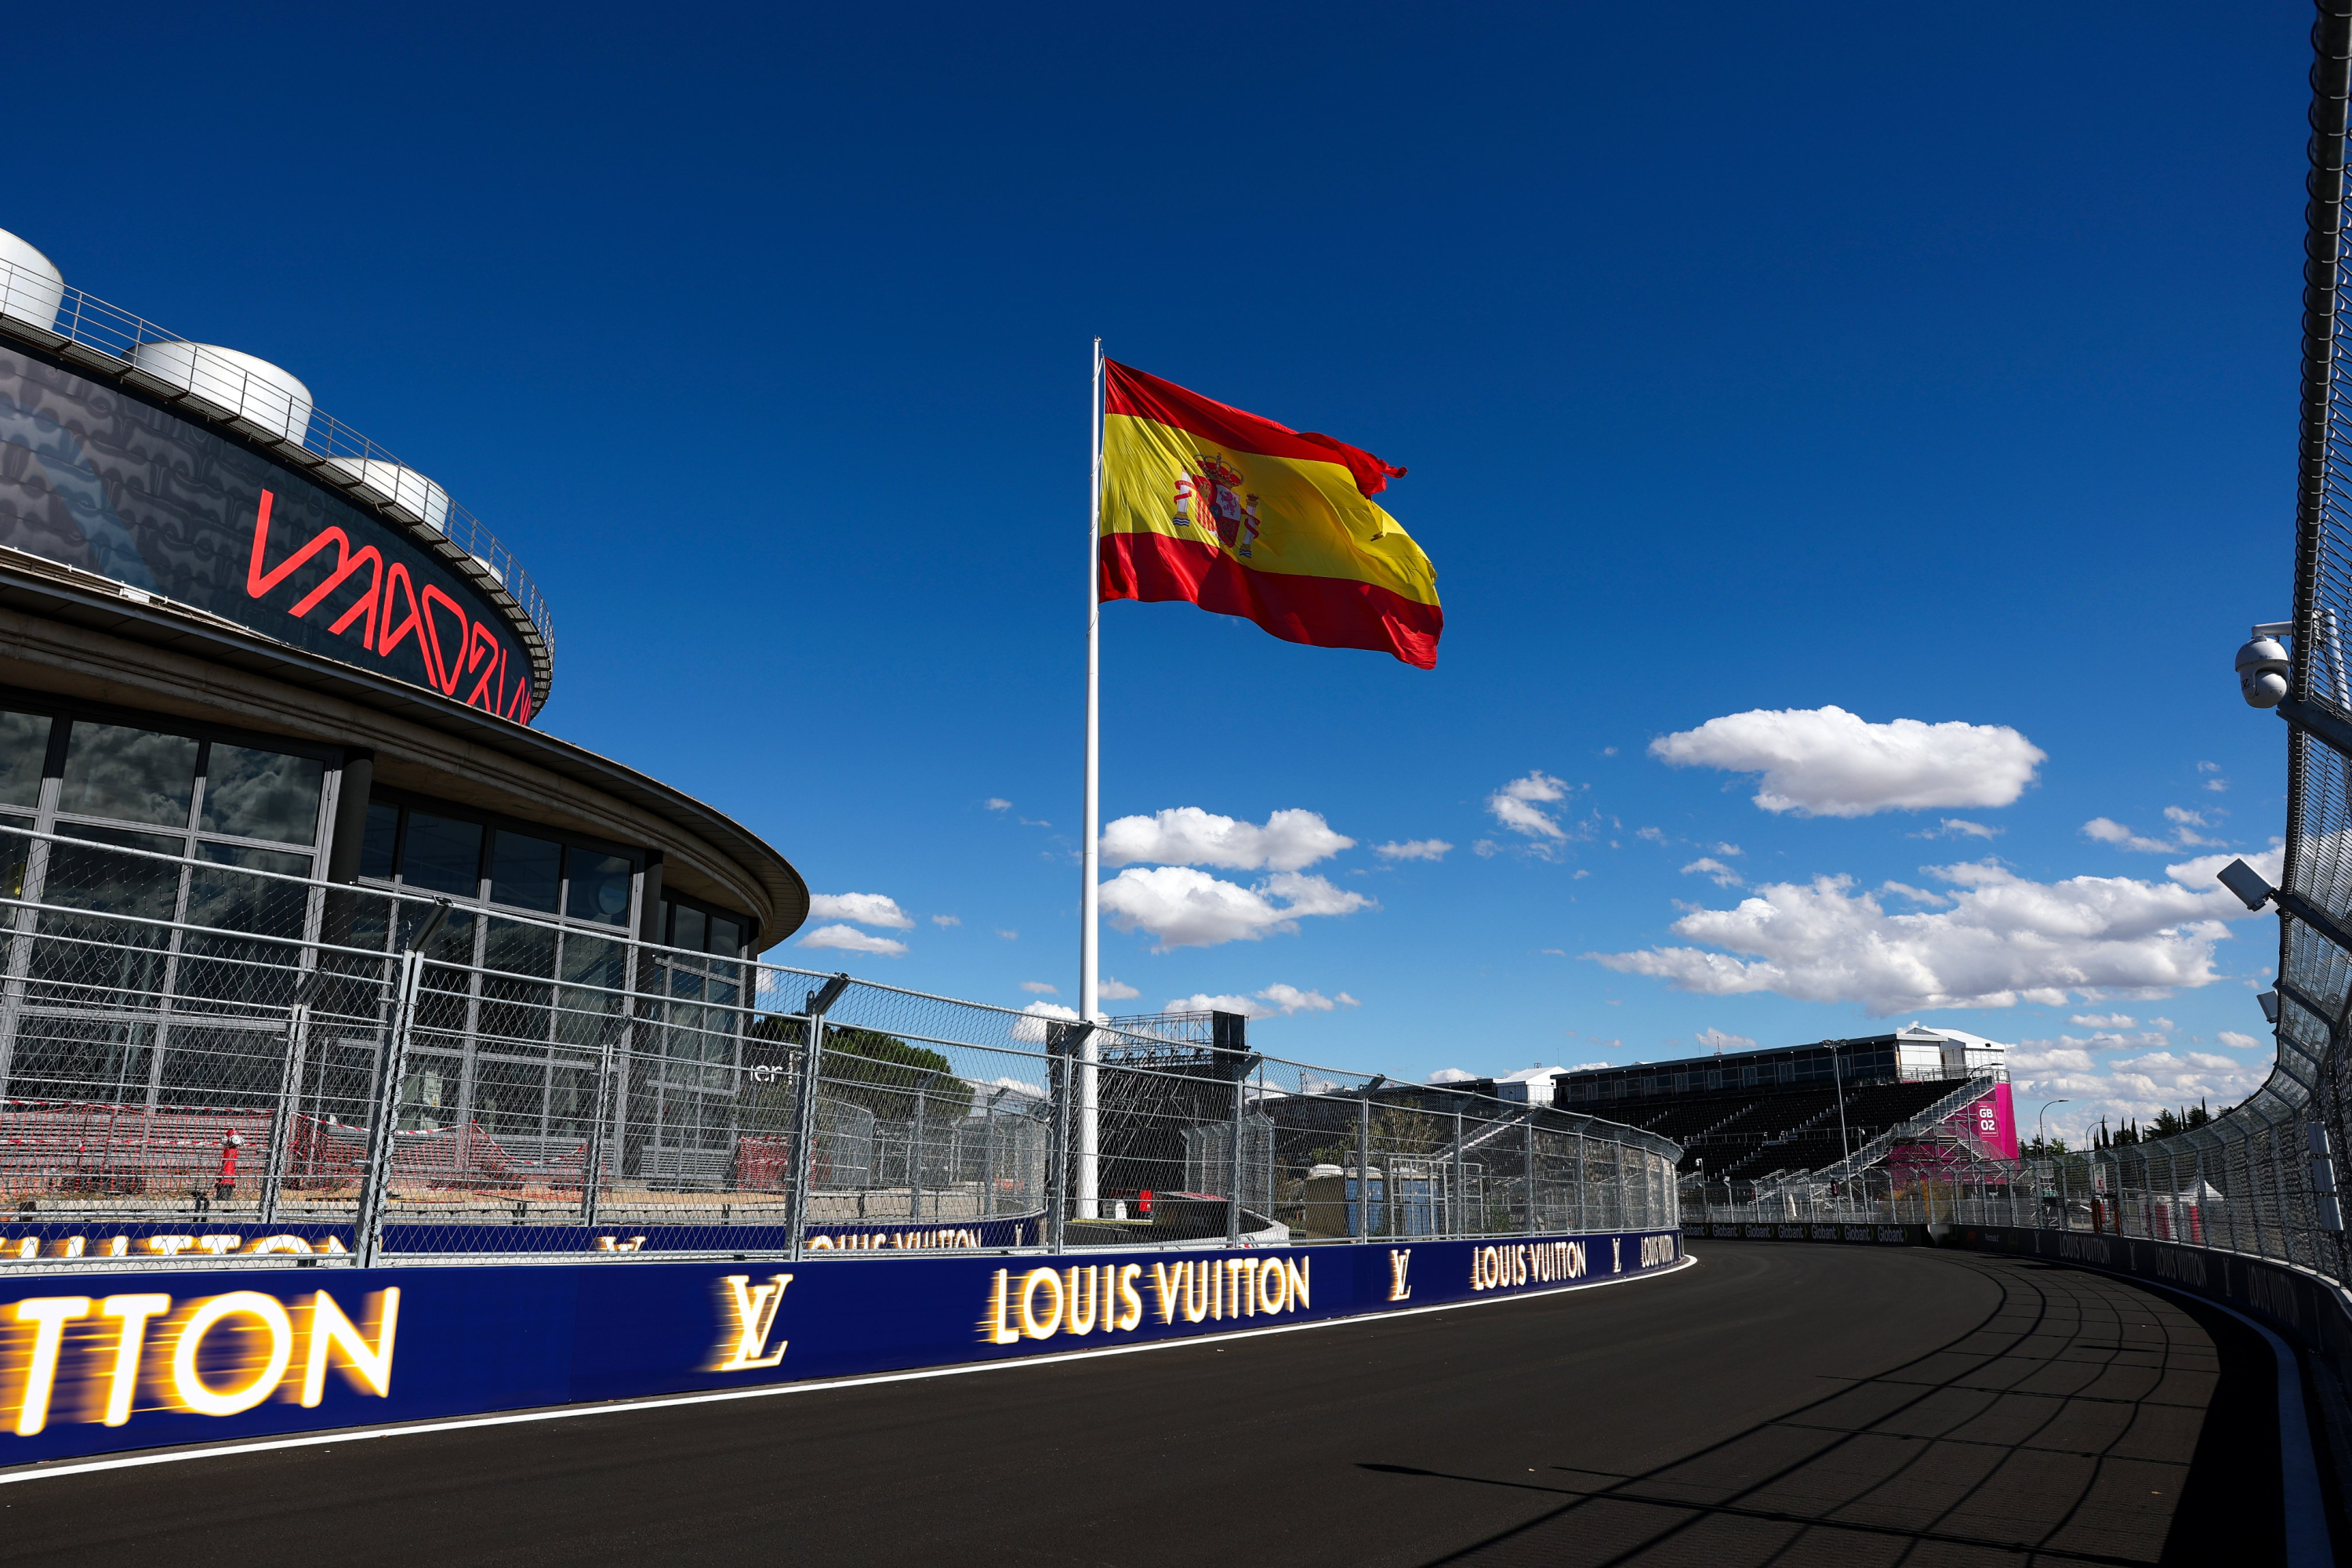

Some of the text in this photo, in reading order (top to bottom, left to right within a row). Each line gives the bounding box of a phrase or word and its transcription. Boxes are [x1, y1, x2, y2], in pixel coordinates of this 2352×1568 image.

[1979, 1108, 1994, 1118] GB
[1980, 1120, 1995, 1131] 02
[1712, 1224, 1738, 1237] Globant
[1745, 1224, 1770, 1238] Globant
[1778, 1225, 1804, 1239] Globant
[1811, 1225, 1837, 1240] Globant
[1844, 1225, 1871, 1241] Globant
[1878, 1225, 1904, 1243] Globant
[1640, 1236, 1659, 1269] LOUIS
[2059, 1233, 2111, 1265] LOUIS VUITTON
[1472, 1240, 1588, 1291] LOUIS VUITTON
[2155, 1246, 2208, 1289] LOUIS VUITTON
[988, 1254, 1311, 1345] LOUIS VUITTON
[13, 1286, 401, 1437] TTON
